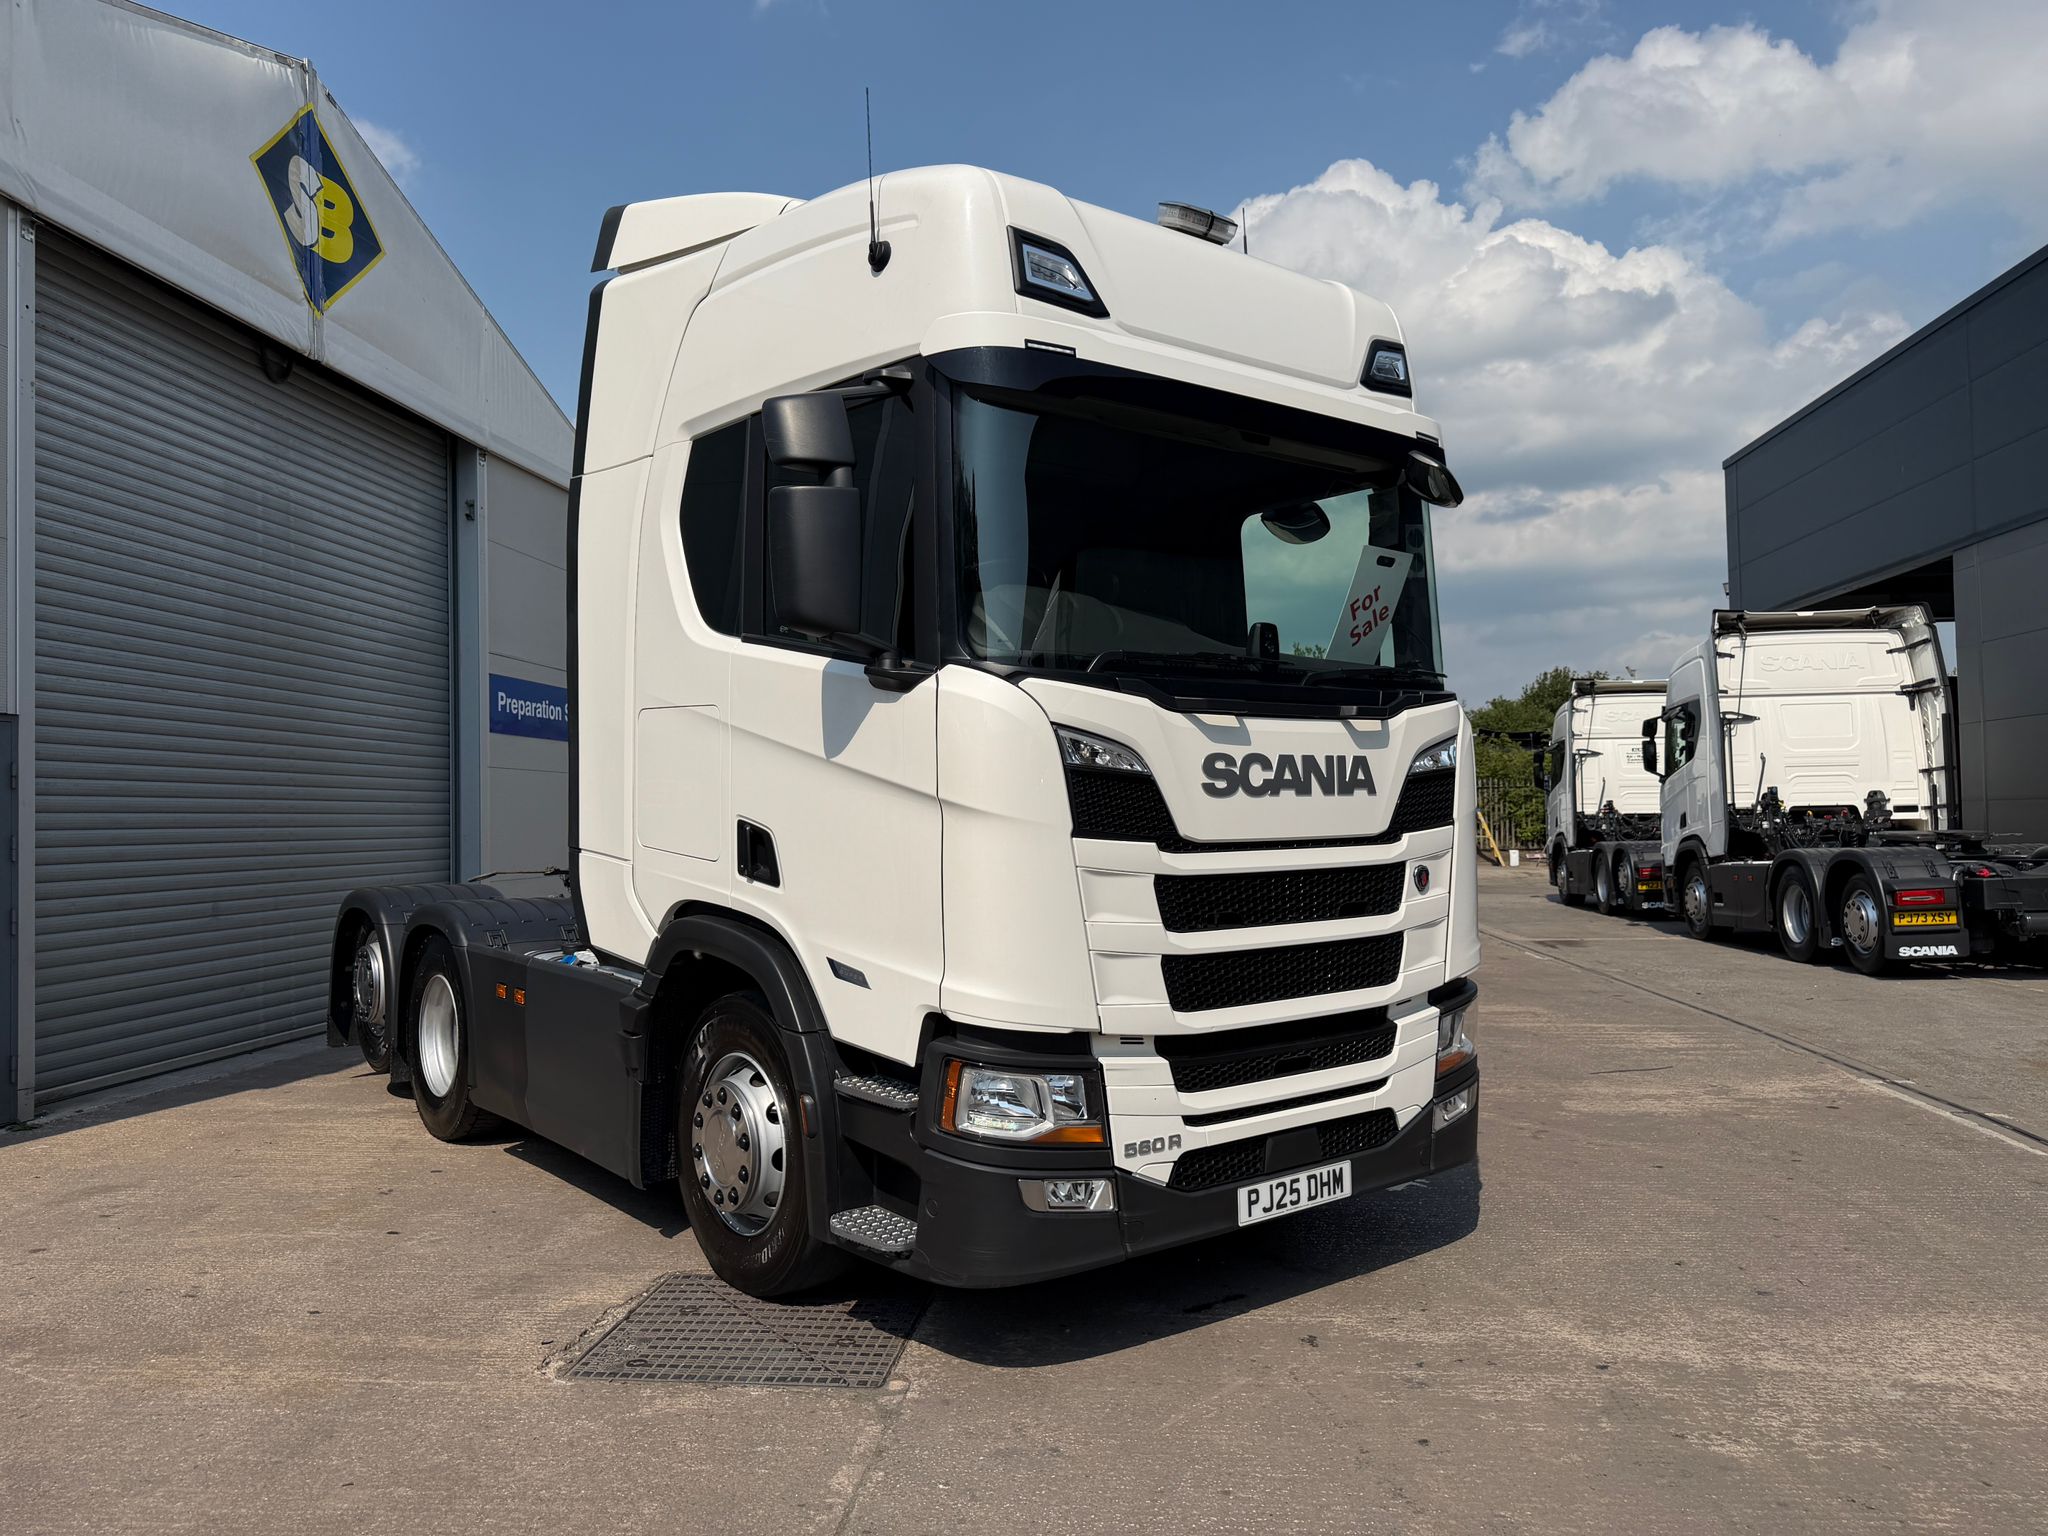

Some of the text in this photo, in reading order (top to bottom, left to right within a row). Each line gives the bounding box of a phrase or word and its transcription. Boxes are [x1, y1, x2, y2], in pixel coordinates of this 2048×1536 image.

[284, 155, 354, 264] SB
[1350, 585, 1382, 622] For
[1350, 604, 1390, 648] Sale
[1760, 649, 1864, 671] SCANIA
[497, 691, 562, 720] Preparation
[1201, 752, 1377, 798] SCANIA
[1898, 912, 1952, 923] PJ73 XSY
[1898, 945, 1958, 957] SCANIA
[1124, 1134, 1182, 1159] 560 R
[1247, 1167, 1344, 1218] PJ25 DHM
